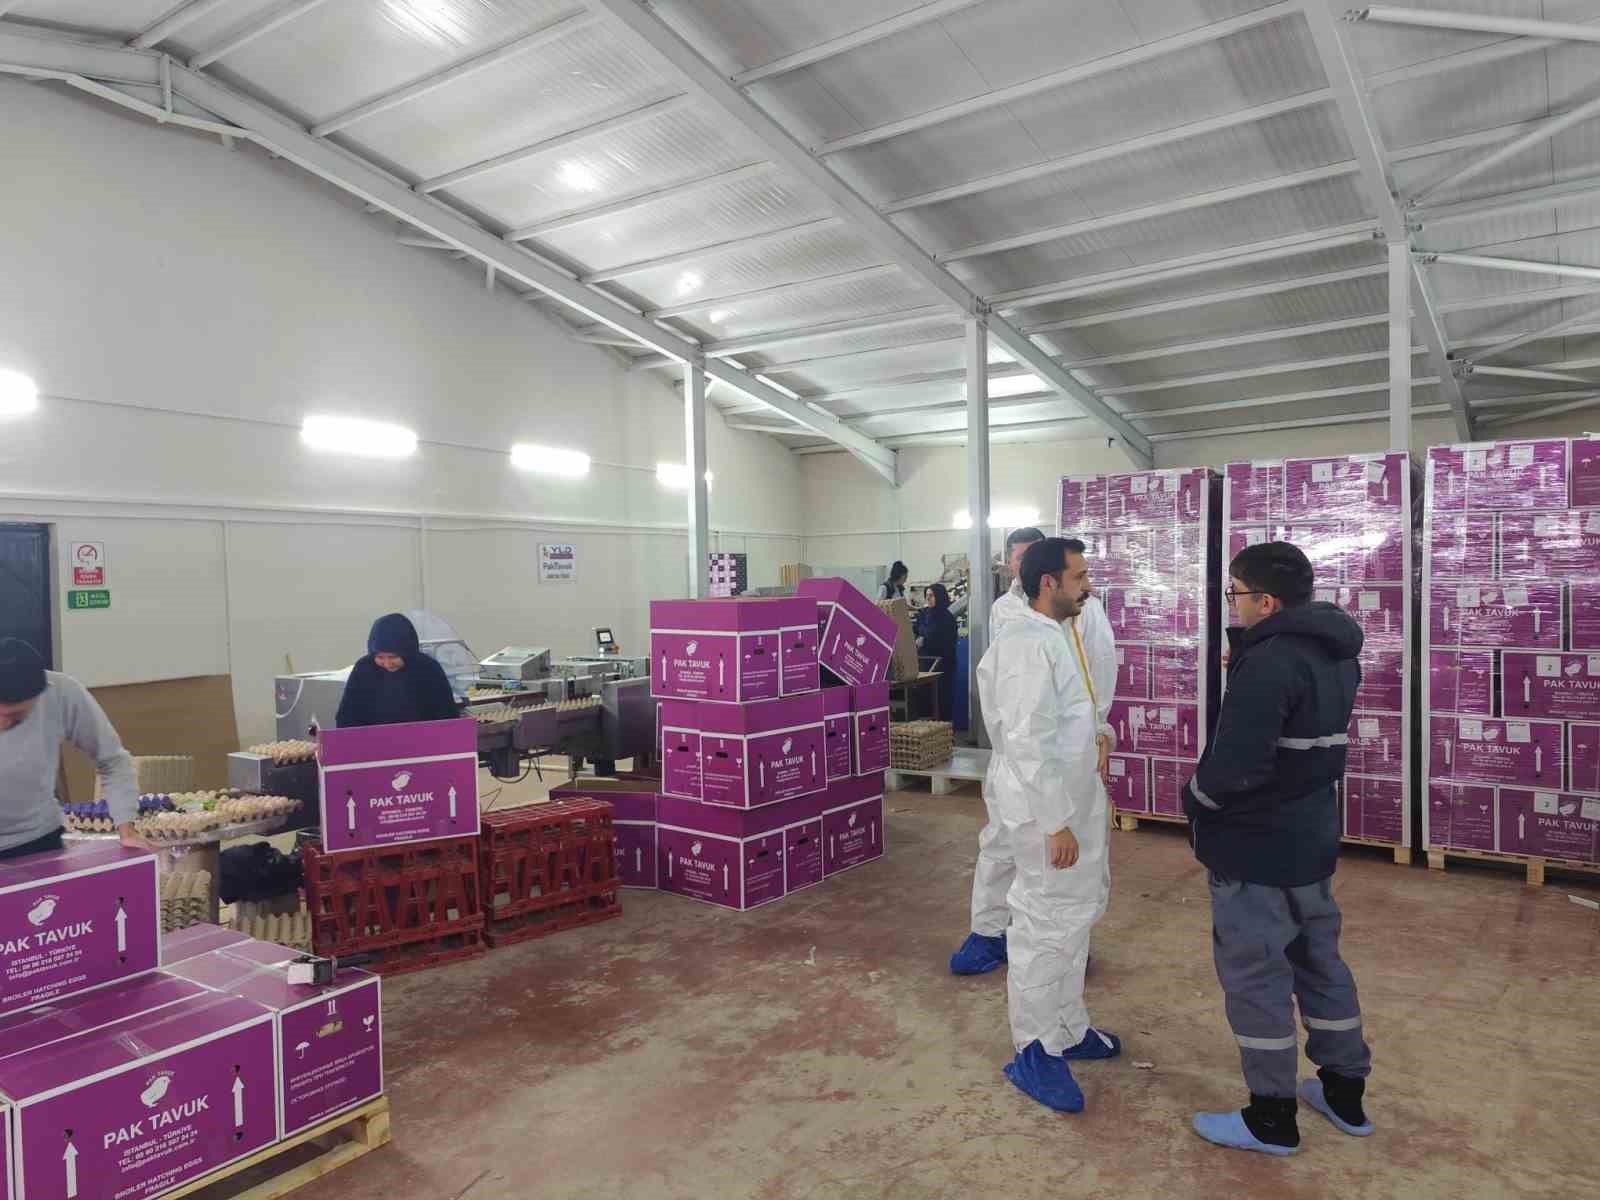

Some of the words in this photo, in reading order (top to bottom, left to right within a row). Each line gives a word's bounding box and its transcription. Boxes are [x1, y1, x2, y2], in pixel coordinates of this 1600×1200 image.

[1544, 680, 1565, 689] PAK
[1463, 742, 1484, 752] PAK
[1486, 744, 1521, 754] TAVUK
[370, 797, 394, 809] PAK
[396, 792, 434, 805] TAVUK
[1538, 817, 1560, 828] PAK
[1564, 820, 1599, 832] TAVUK
[34, 920, 94, 946] TAVUK
[103, 1121, 144, 1150] PAK
[148, 1095, 209, 1131] TAVUK
